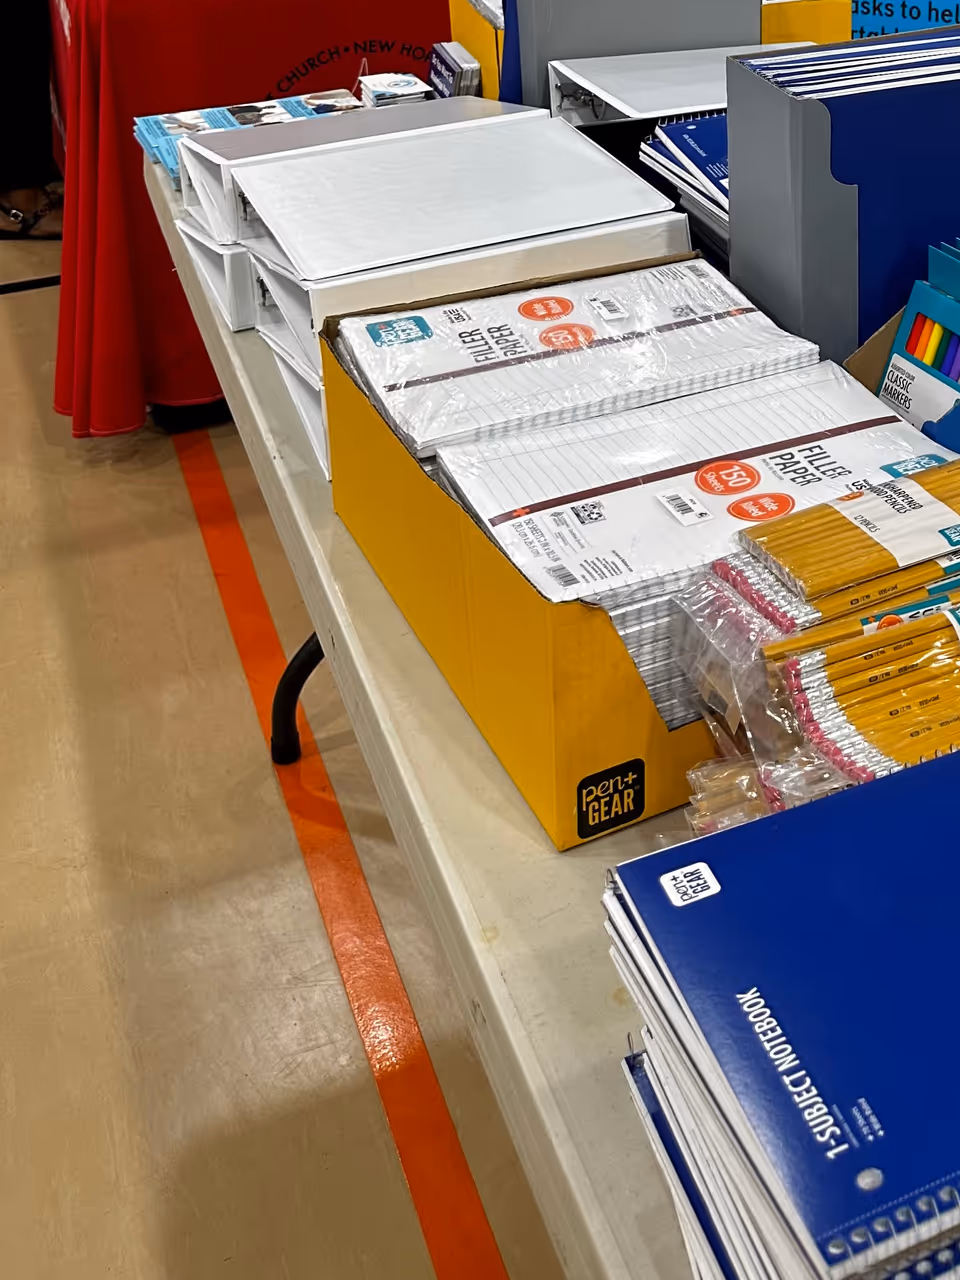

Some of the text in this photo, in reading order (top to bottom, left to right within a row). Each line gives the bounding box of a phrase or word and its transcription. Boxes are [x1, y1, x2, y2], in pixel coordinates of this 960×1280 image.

[900, 0, 921, 20] to
[276, 45, 341, 95] CHURCH
[354, 40, 397, 54] NEW
[458, 327, 497, 364] FILLER
[487, 322, 528, 358] PAPER
[886, 369, 913, 394] CLASSIC
[881, 382, 913, 410] MARKERS
[769, 452, 823, 487] PAPER
[798, 444, 853, 480] FILLER
[702, 471, 725, 493] Sheets
[718, 465, 751, 488] 150
[851, 480, 868, 492] US
[740, 501, 768, 518] Ruled
[758, 496, 780, 512] Wide
[884, 494, 912, 514] PENCILS
[860, 520, 881, 533] PENCILS
[582, 772, 637, 811] pen+
[588, 788, 635, 826] GEAR
[670, 874, 699, 902] pen+
[683, 868, 711, 894] GEAR
[735, 986, 801, 1072] NOTEBOOK
[782, 1069, 850, 1160] 1-SUBJECT
